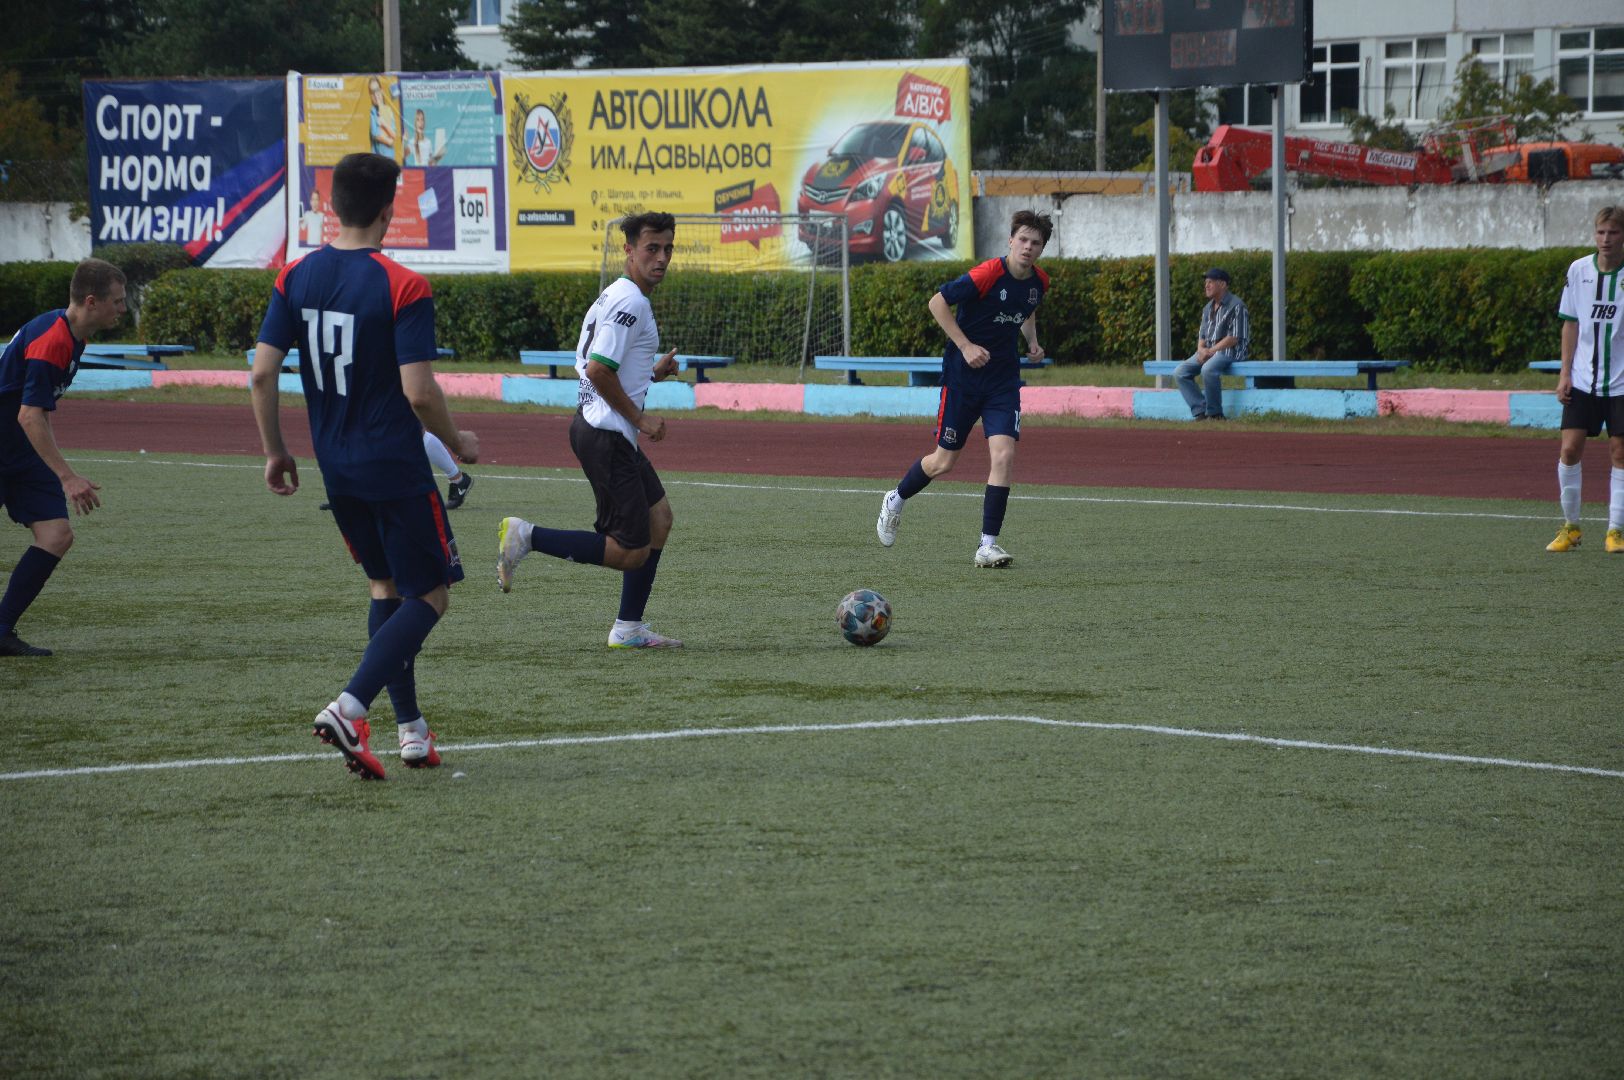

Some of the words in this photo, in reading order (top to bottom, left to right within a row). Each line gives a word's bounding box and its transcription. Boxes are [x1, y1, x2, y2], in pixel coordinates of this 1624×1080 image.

[96, 94, 202, 152] Спорт
[210, 116, 222, 127] -
[588, 86, 773, 131] АВТОШКОЛА
[99, 155, 212, 202] норма
[1368, 151, 1413, 169] MEGALIFT
[98, 197, 225, 242] жизни!
[458, 195, 484, 223] top
[301, 308, 354, 397] 17
